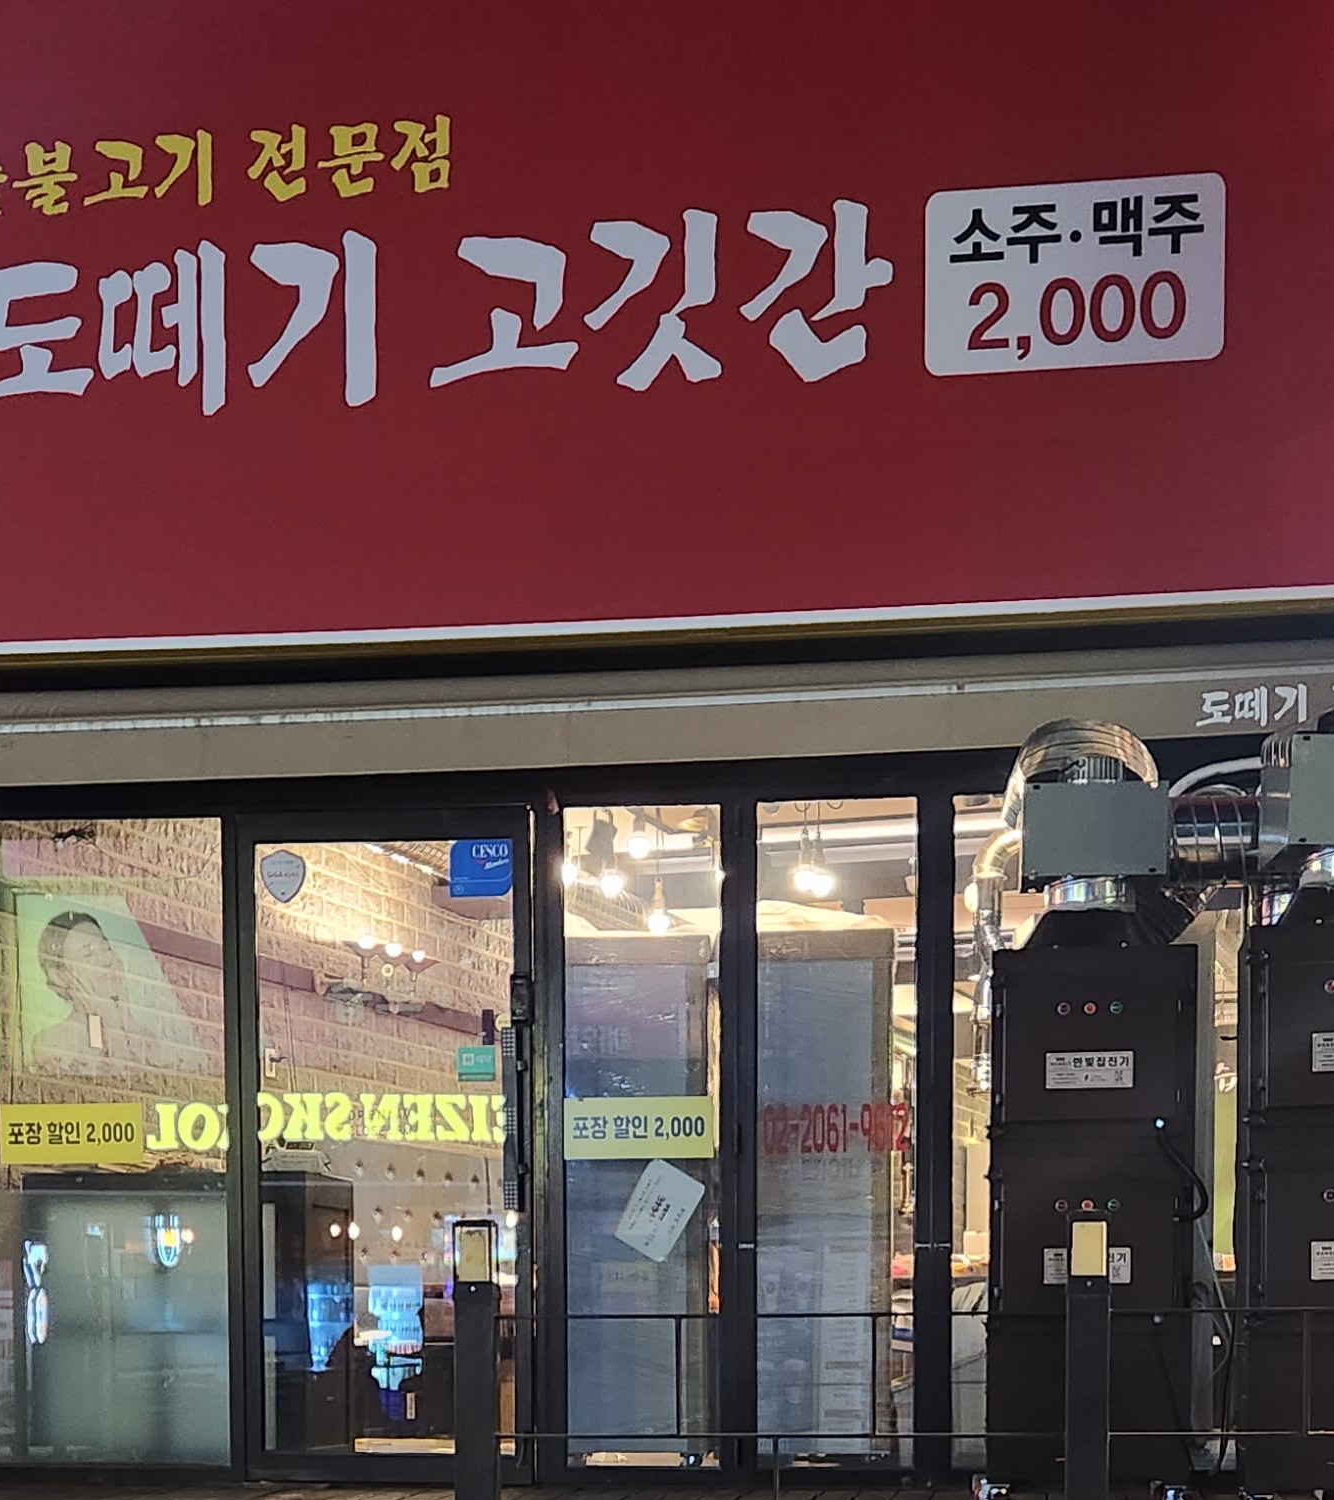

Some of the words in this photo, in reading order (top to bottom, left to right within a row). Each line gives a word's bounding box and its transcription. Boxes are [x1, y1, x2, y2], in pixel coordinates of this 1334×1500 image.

[247, 112, 455, 200] 전문점
[426, 200, 893, 394] 고깃간
[966, 270, 1187, 359] 2,000
[1195, 682, 1308, 728] 도떼기
[471, 843, 509, 858] CESCO
[8, 1121, 43, 1145] 포장
[46, 1121, 81, 1145] 할인
[86, 1121, 135, 1147] 2,000
[572, 1115, 609, 1140] 포장
[613, 1115, 649, 1140] 할인
[654, 1115, 706, 1141] 2,000
